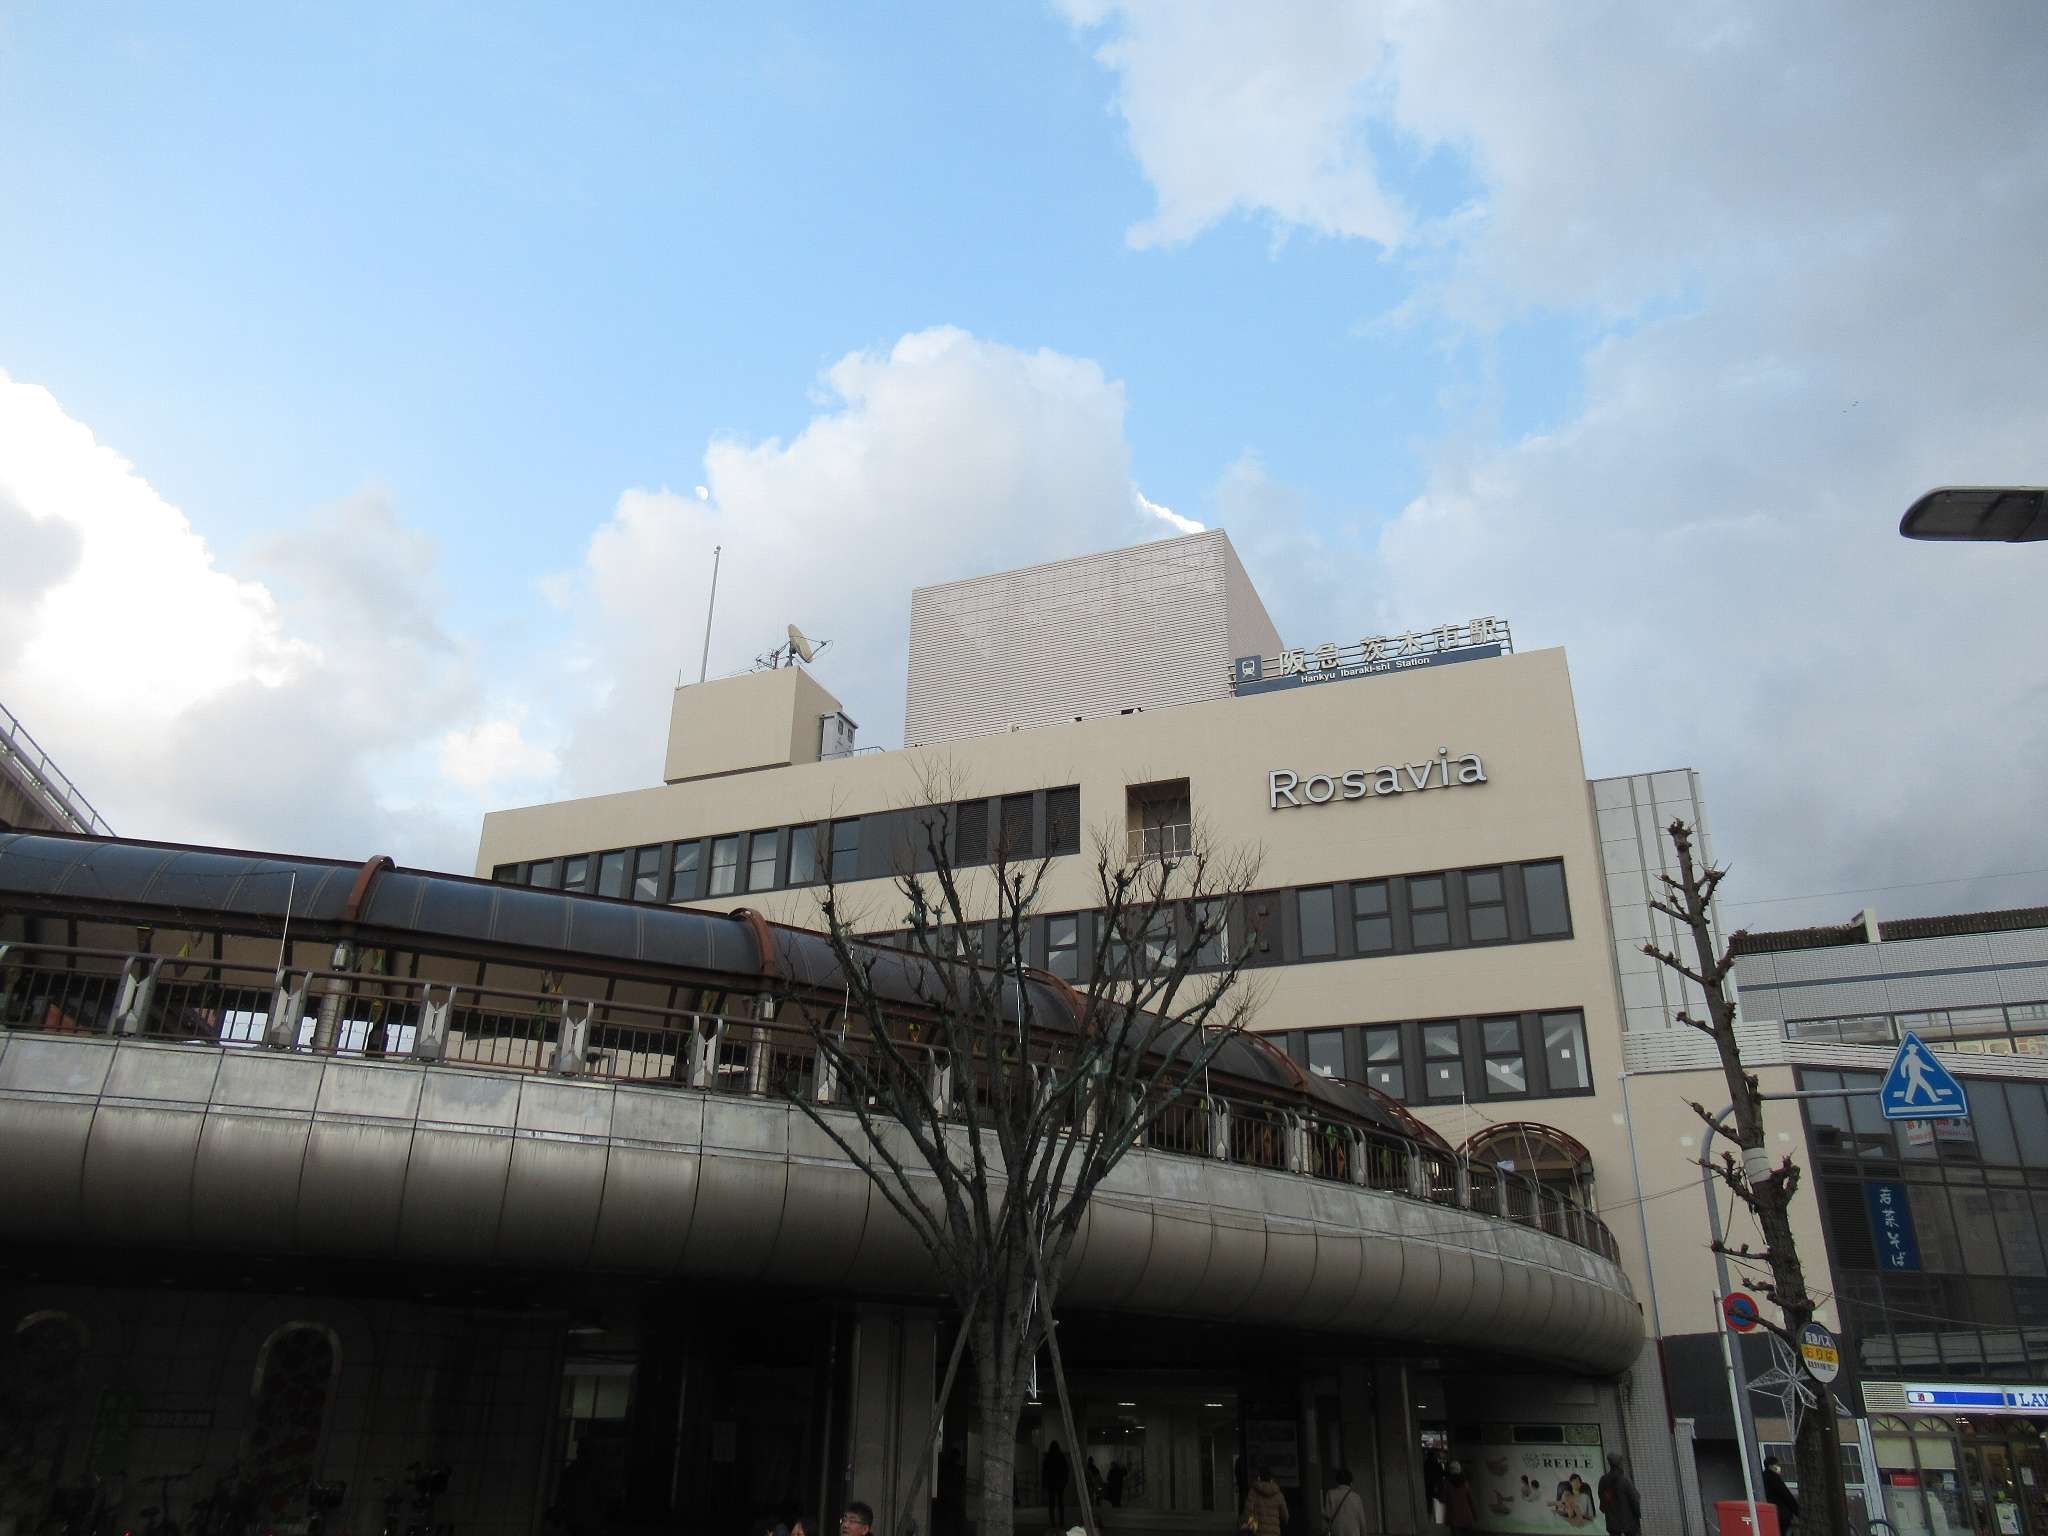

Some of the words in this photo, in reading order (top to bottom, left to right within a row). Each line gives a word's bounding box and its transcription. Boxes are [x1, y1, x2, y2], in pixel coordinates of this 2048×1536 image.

[1279, 643, 1342, 676] 阪急
[1360, 616, 1501, 662] 茨木市駅
[1301, 671, 1336, 684] Hankyu
[1340, 663, 1391, 678] Ibaraki-shi
[1396, 656, 1430, 668] Station
[1268, 746, 1488, 810] Rosavia
[1880, 1186, 1906, 1267] 若菜そば
